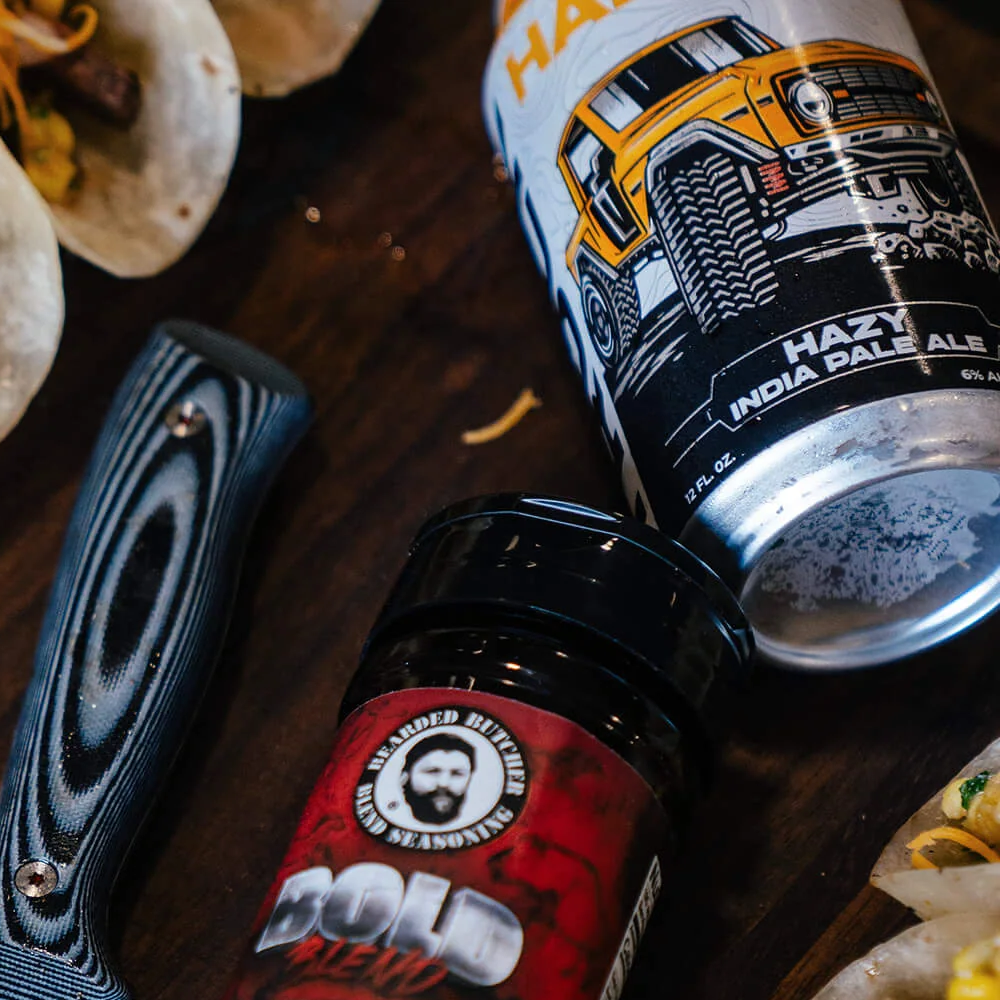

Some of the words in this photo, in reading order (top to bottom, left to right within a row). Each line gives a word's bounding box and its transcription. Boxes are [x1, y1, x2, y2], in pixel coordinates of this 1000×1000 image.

[506, 0, 628, 105] HA
[782, 308, 909, 365] HAZY
[728, 364, 819, 422] INDIA
[822, 335, 918, 373] PALE
[927, 333, 988, 353] ALE
[961, 368, 985, 381] 6%
[684, 488, 697, 505] 12
[695, 474, 715, 493] FL.
[714, 452, 737, 474] OZ.
[367, 709, 460, 771] BEARDED
[463, 711, 527, 797] BUTCHER
[355, 782, 388, 836] BLEND
[384, 799, 515, 850] SEASONING
[255, 861, 525, 987] BOLD
[286, 935, 450, 996] BLEND
